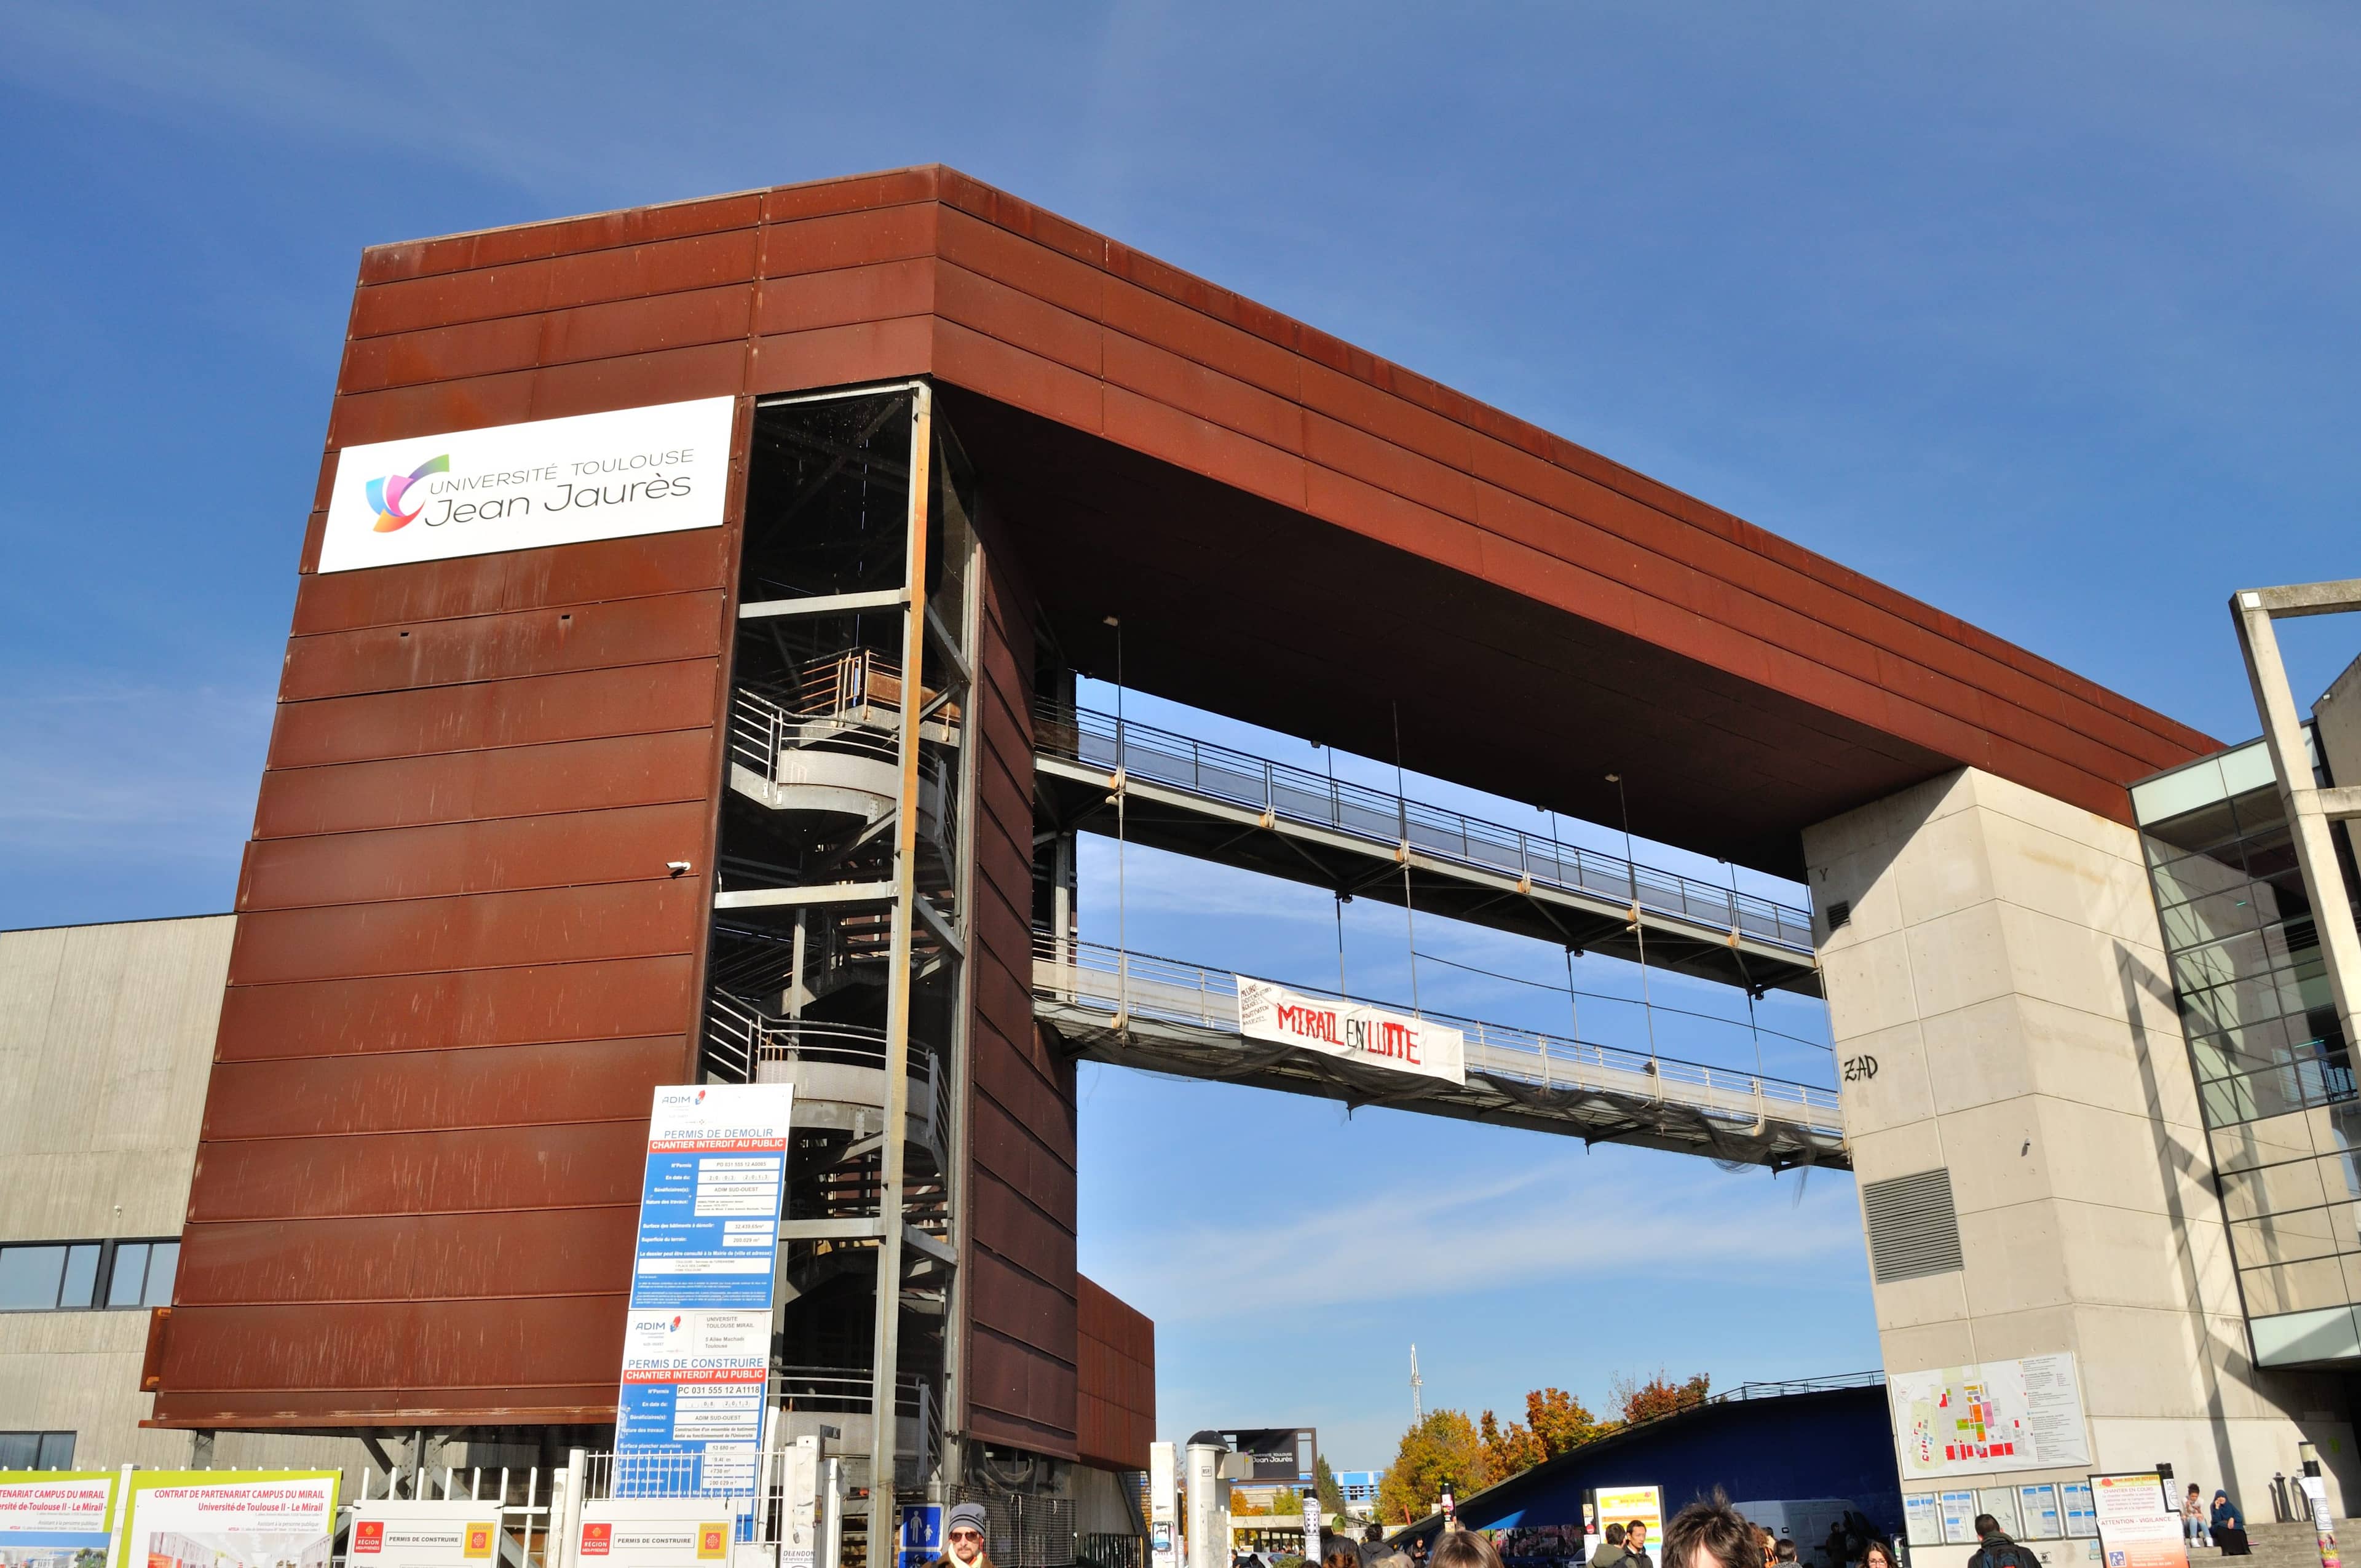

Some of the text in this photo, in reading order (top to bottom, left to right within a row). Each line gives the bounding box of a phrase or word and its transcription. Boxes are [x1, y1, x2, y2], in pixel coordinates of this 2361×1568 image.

[430, 448, 695, 495] UNIVERSITÉ TOULOUSE
[424, 472, 692, 527] Jean Jaurès
[1277, 1003, 1421, 1065] MIRAIL EN LUTTE
[1844, 1055, 1878, 1082] ZAD
[664, 1130, 703, 1139] PERMIS
[724, 1128, 773, 1138] DEMOLIR
[652, 1140, 694, 1149] CHANTIER
[696, 1139, 735, 1148] INTERDIT
[751, 1139, 784, 1147] PUBLIC
[628, 1358, 763, 1368] PERMIS DE CONSTRUIRE
[626, 1371, 671, 1380] CHANTIER
[673, 1371, 712, 1379] INTERDIT
[730, 1370, 763, 1379] PUBLIC
[154, 1490, 188, 1499] CONTRAT
[189, 1490, 199, 1499] DE
[200, 1490, 251, 1499] PARTENARIAT
[252, 1490, 284, 1499] CAMPUS
[285, 1490, 296, 1499] DU
[18, 1502, 28, 1511] de
[82, 1503, 103, 1511] Mirail
[198, 1502, 235, 1511] Université
[236, 1502, 245, 1511] de
[247, 1503, 279, 1511] Toulouse
[301, 1503, 323, 1511] Mirail
